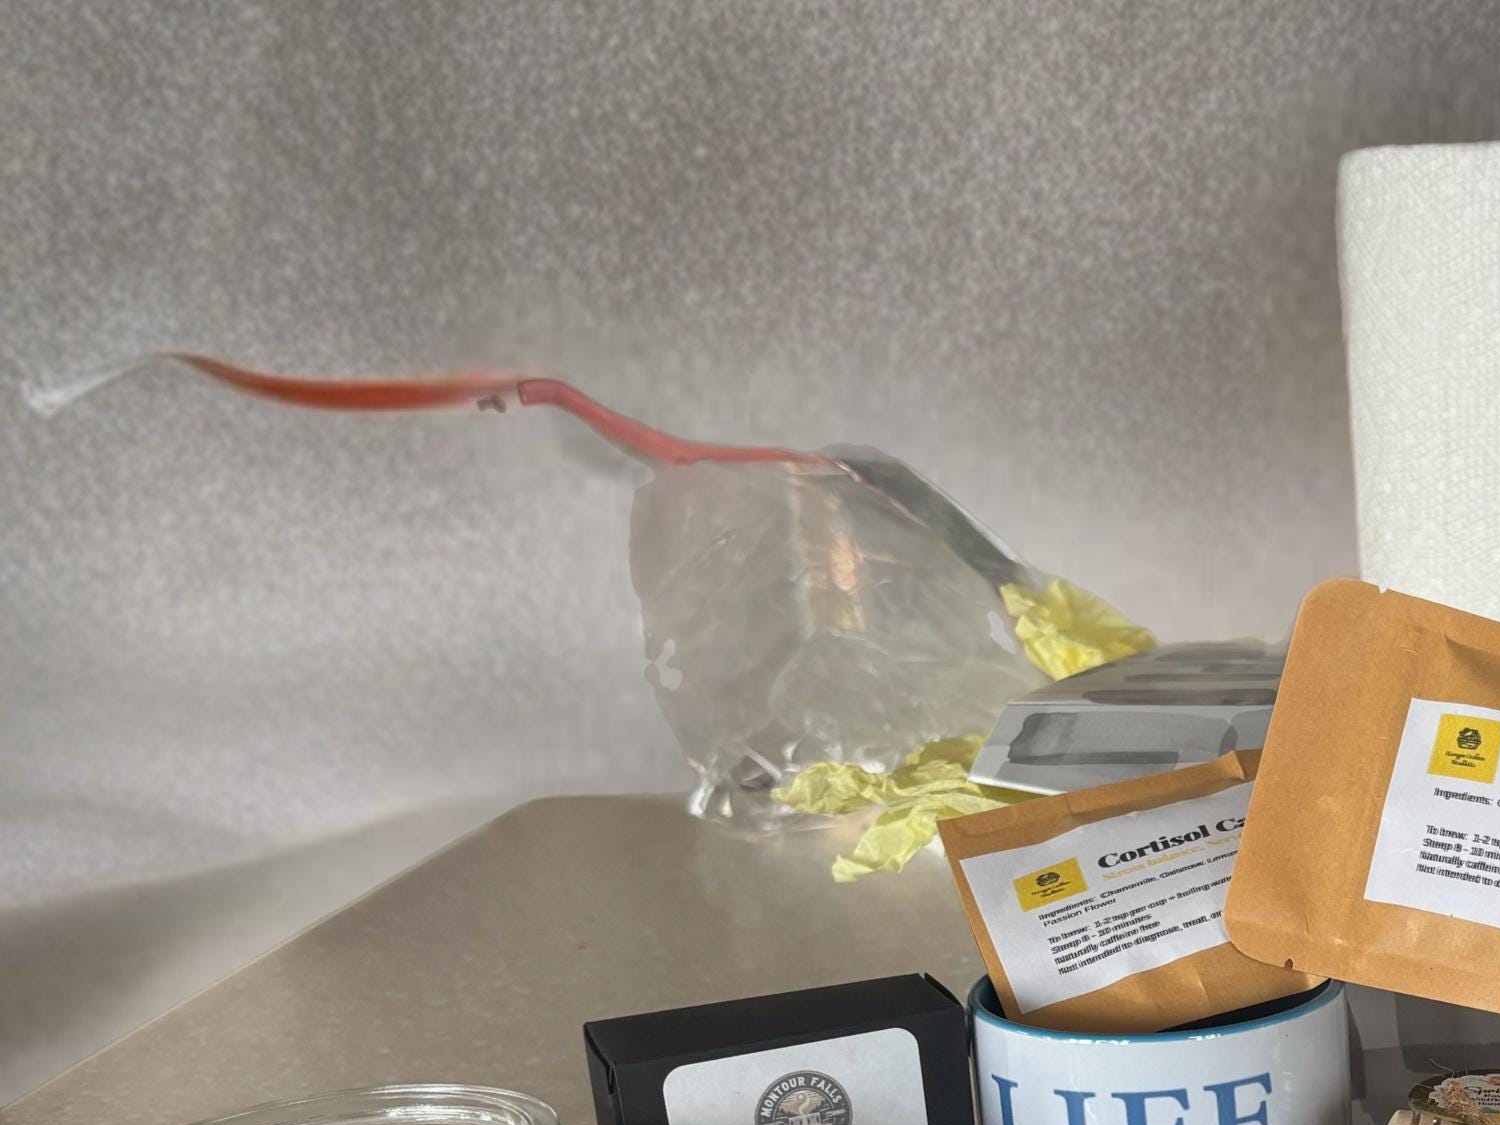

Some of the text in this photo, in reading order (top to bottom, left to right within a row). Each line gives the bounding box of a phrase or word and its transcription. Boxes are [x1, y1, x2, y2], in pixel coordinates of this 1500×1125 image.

[1097, 824, 1211, 869] Cortisol
[1043, 898, 1117, 928] Passion Flower
[760, 1076, 842, 1118] MONTOUR FALLS
